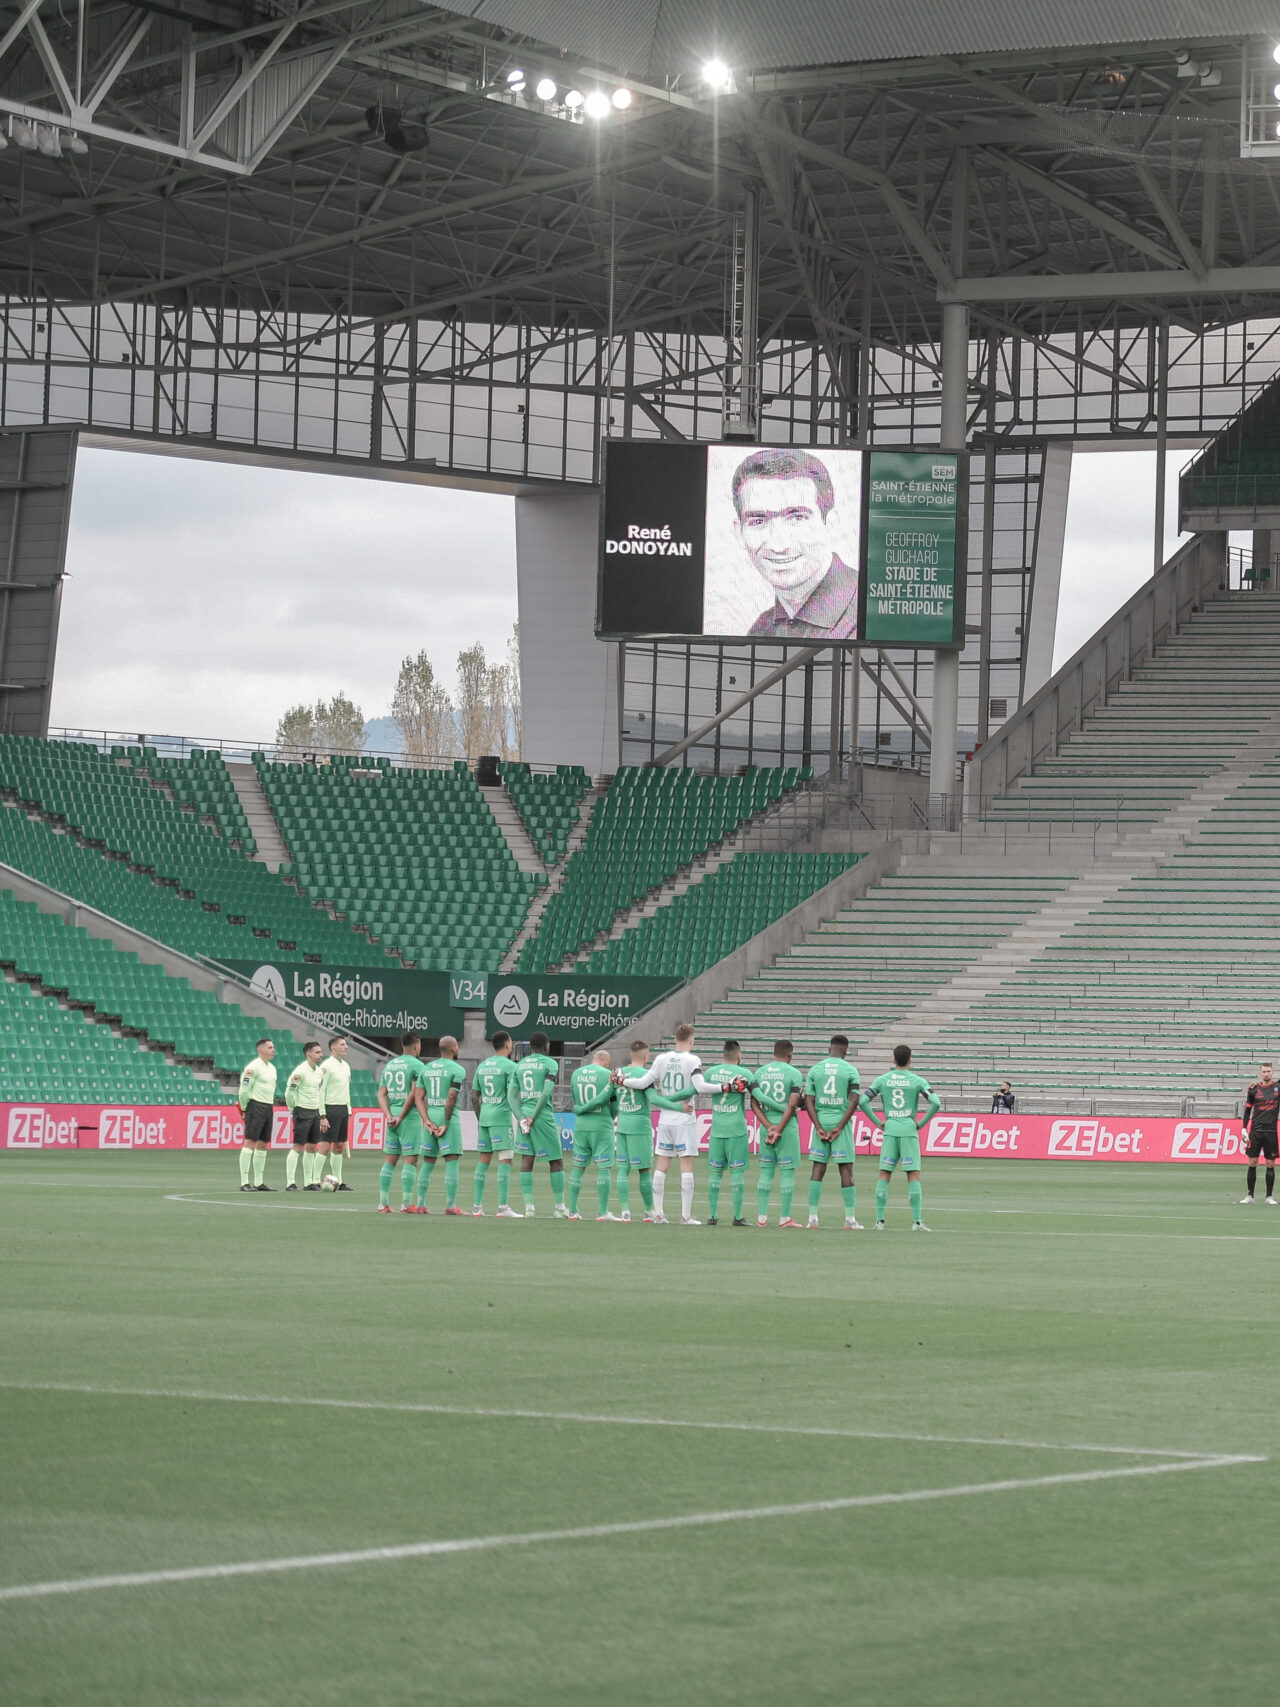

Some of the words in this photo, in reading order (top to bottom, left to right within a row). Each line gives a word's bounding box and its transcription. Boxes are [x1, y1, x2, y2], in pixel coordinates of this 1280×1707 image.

[872, 480, 955, 492] SAINT-ÉTIENNE
[871, 491, 882, 502] la
[886, 493, 955, 507] métropole
[627, 525, 671, 541] René
[885, 532, 940, 548] GEOFFROY
[605, 540, 692, 557] DONOYAN
[885, 549, 939, 565] GUICHARD
[885, 566, 920, 581] STADE
[923, 567, 938, 582] DE
[869, 581, 953, 599] SAINT-ÉTIENNE
[878, 598, 944, 616] MÉTROPOLE
[293, 971, 315, 998] La
[319, 972, 384, 1005] Région
[451, 978, 487, 1001] V34
[537, 988, 558, 1007] La
[563, 988, 630, 1012] Région
[384, 1070, 406, 1092] 29
[429, 1076, 441, 1098] 11
[484, 1075, 494, 1097] 5
[522, 1070, 534, 1091] 6
[661, 1072, 685, 1094] 40
[823, 1076, 837, 1098] 4
[577, 1083, 597, 1105] 10
[617, 1086, 637, 1107] 21
[760, 1081, 786, 1103] 28
[891, 1088, 905, 1109] 8
[12, 1113, 79, 1145] ZEbet
[103, 1114, 167, 1145] ZEbet
[191, 1116, 245, 1146] ZEbe
[933, 1122, 1020, 1150] ZEbet
[1054, 1125, 1143, 1154] ZEbet
